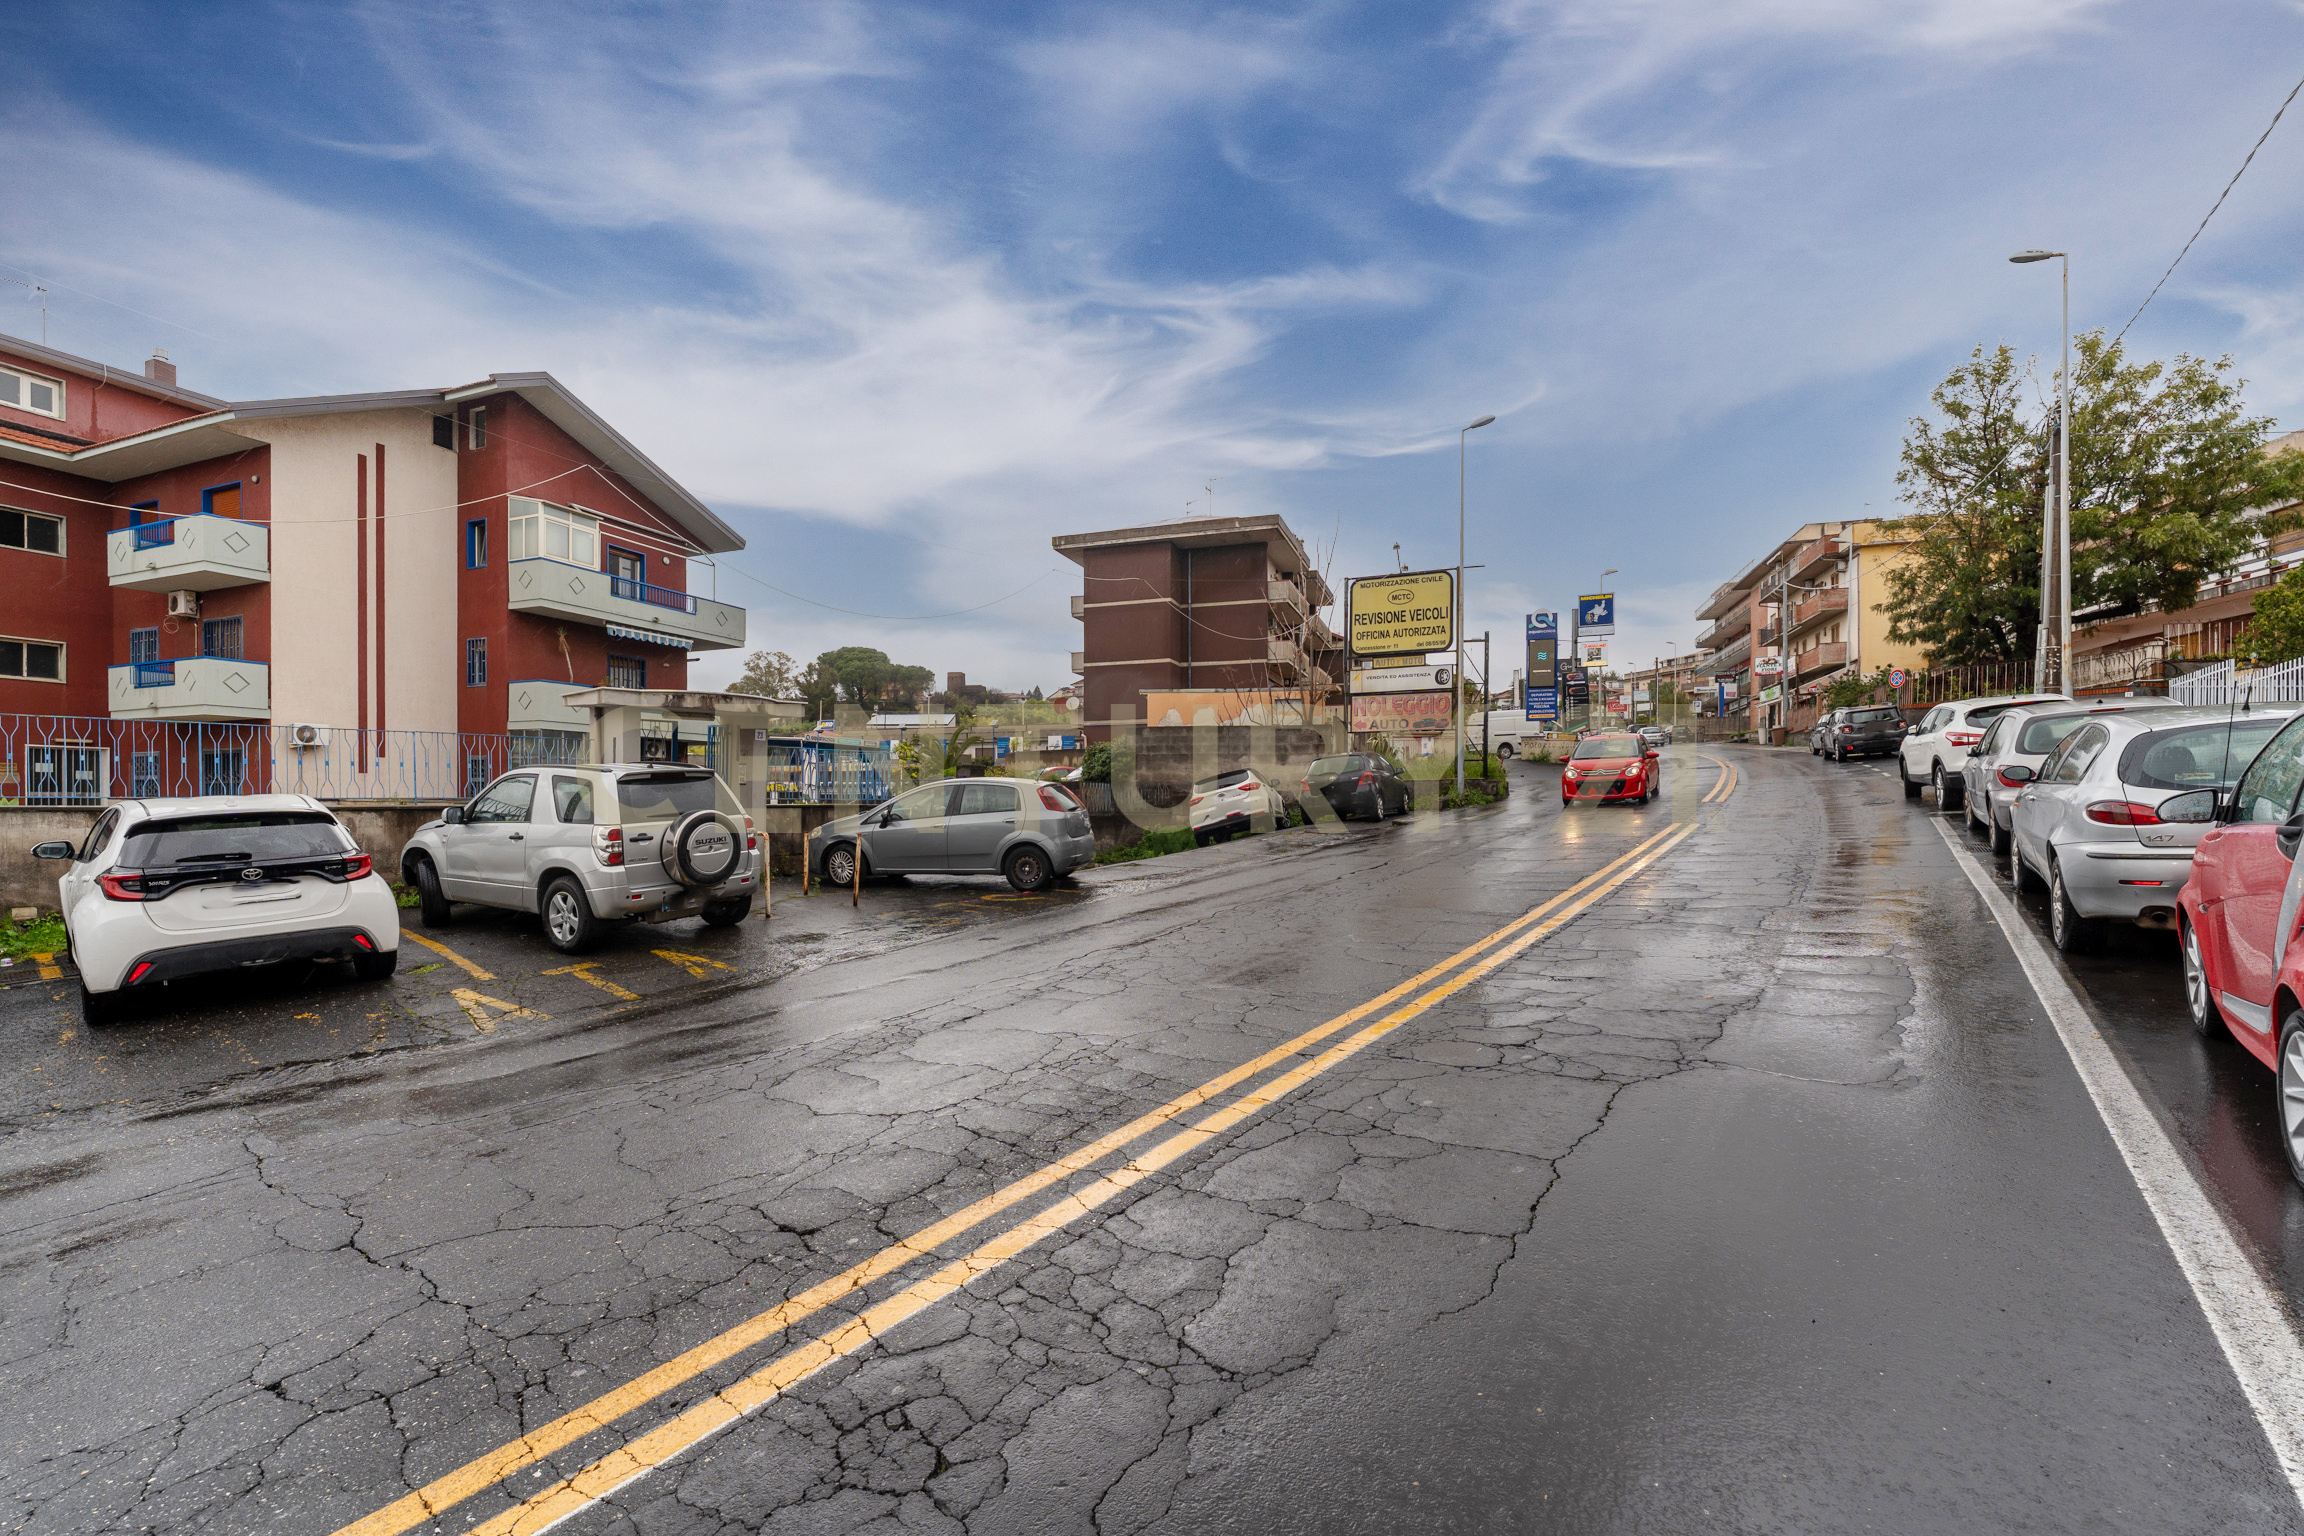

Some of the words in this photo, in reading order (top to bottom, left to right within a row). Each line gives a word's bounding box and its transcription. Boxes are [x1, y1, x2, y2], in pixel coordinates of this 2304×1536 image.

[1360, 578, 1420, 589] MOTORIZZAZIONE
[1421, 575, 1443, 583] CIVILE
[1391, 593, 1411, 601] MCTC
[1354, 610, 1406, 626] REVISIONE
[1409, 606, 1449, 622] VEICOLI
[1356, 629, 1391, 641] OFFICINA
[1393, 625, 1446, 638] AUTORIZZATA
[1355, 644, 1386, 652] Concessione
[1375, 658, 1396, 667] AUTO
[1402, 656, 1424, 665] MOTO
[1397, 672, 1432, 680] ASSISTENZA
[1353, 694, 1450, 717] NOLEGGIO
[1369, 718, 1409, 730] AUTO
[757, 731, 764, 739] 23
[695, 835, 727, 846] SUZUKI
[2145, 834, 2175, 843] 147
